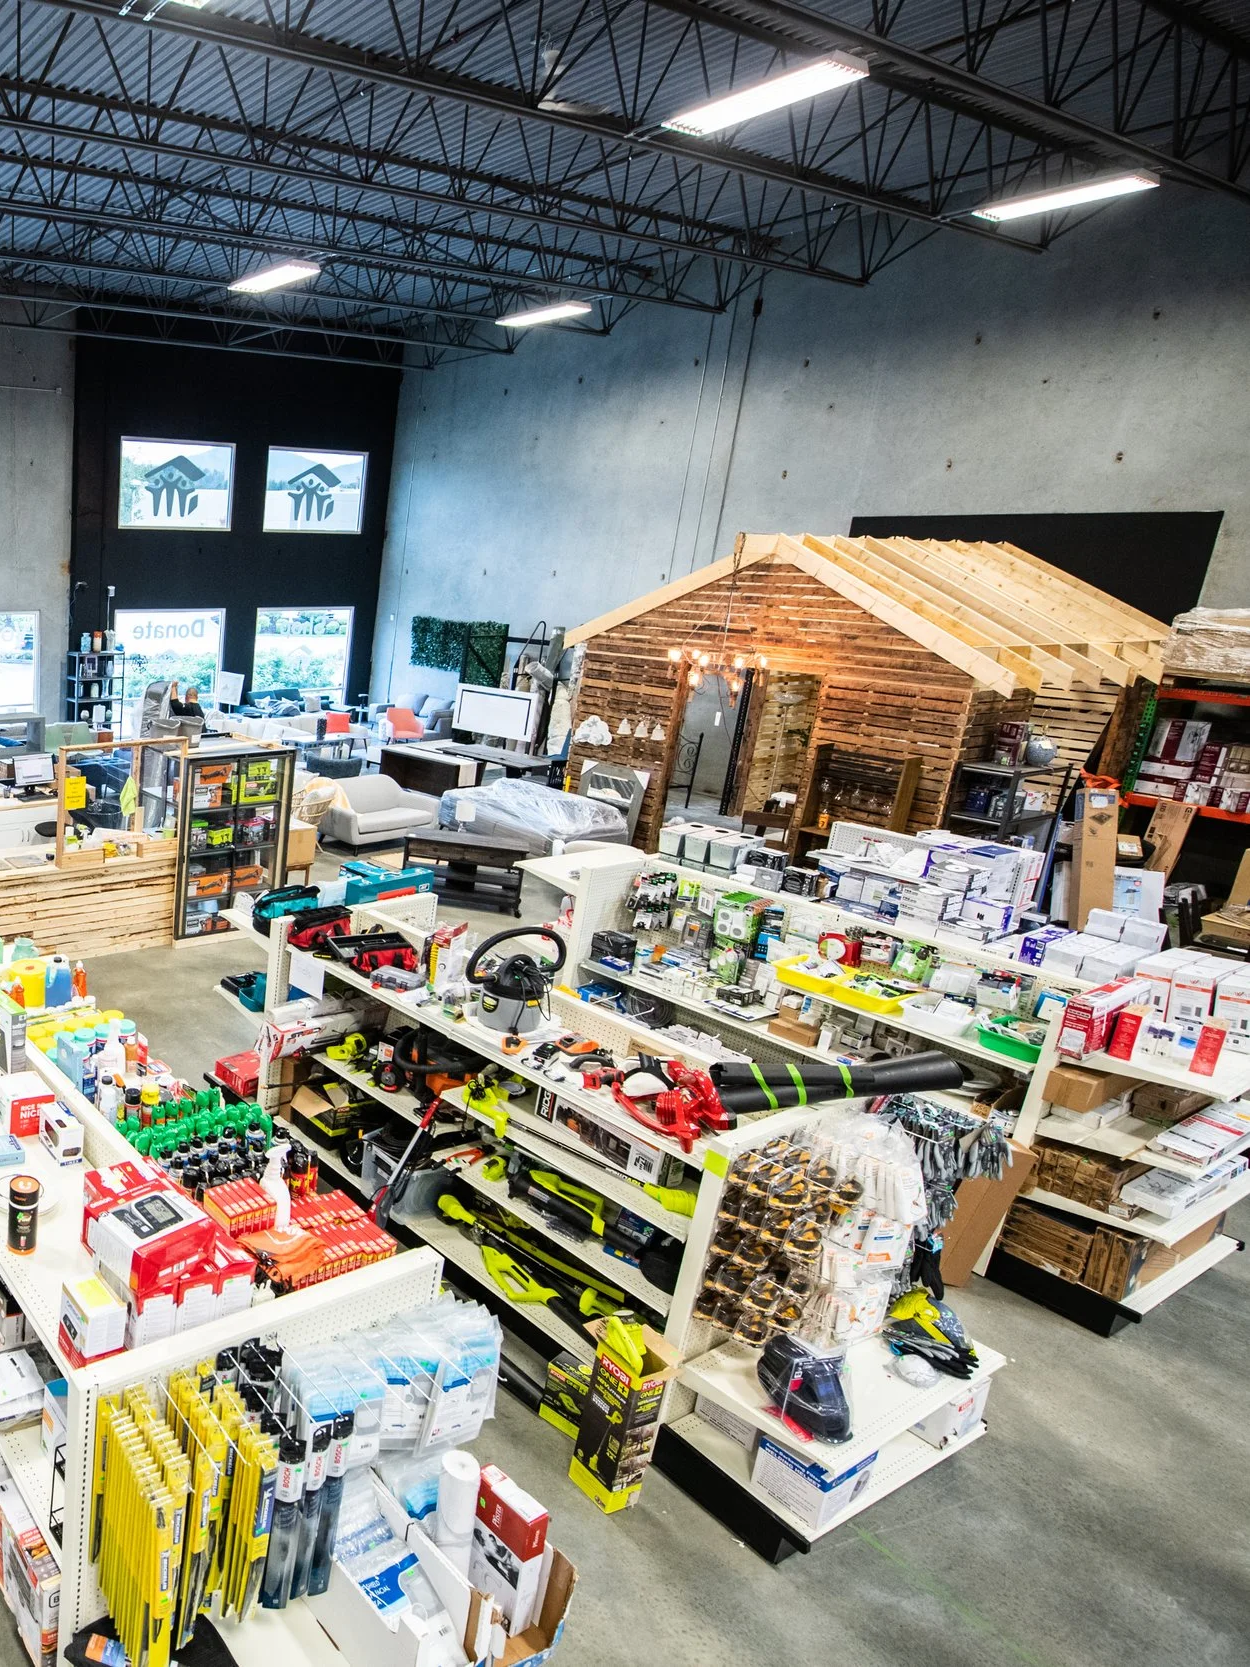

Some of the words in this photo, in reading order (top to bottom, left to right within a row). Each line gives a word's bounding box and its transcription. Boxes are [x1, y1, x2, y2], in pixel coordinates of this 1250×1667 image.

[20, 1103, 36, 1112] RICE
[601, 1354, 631, 1388] RYOBI
[226, 1446, 235, 1476] MICHELIN
[314, 1455, 324, 1478] BOSCH
[333, 1443, 343, 1465] BOSCH
[765, 1446, 795, 1472] WELDING
[794, 1469, 822, 1490] HELMET
[282, 1466, 292, 1490] BOSCH
[261, 1499, 271, 1530] MICHELIN
[161, 1558, 169, 1591] MICHELIN
